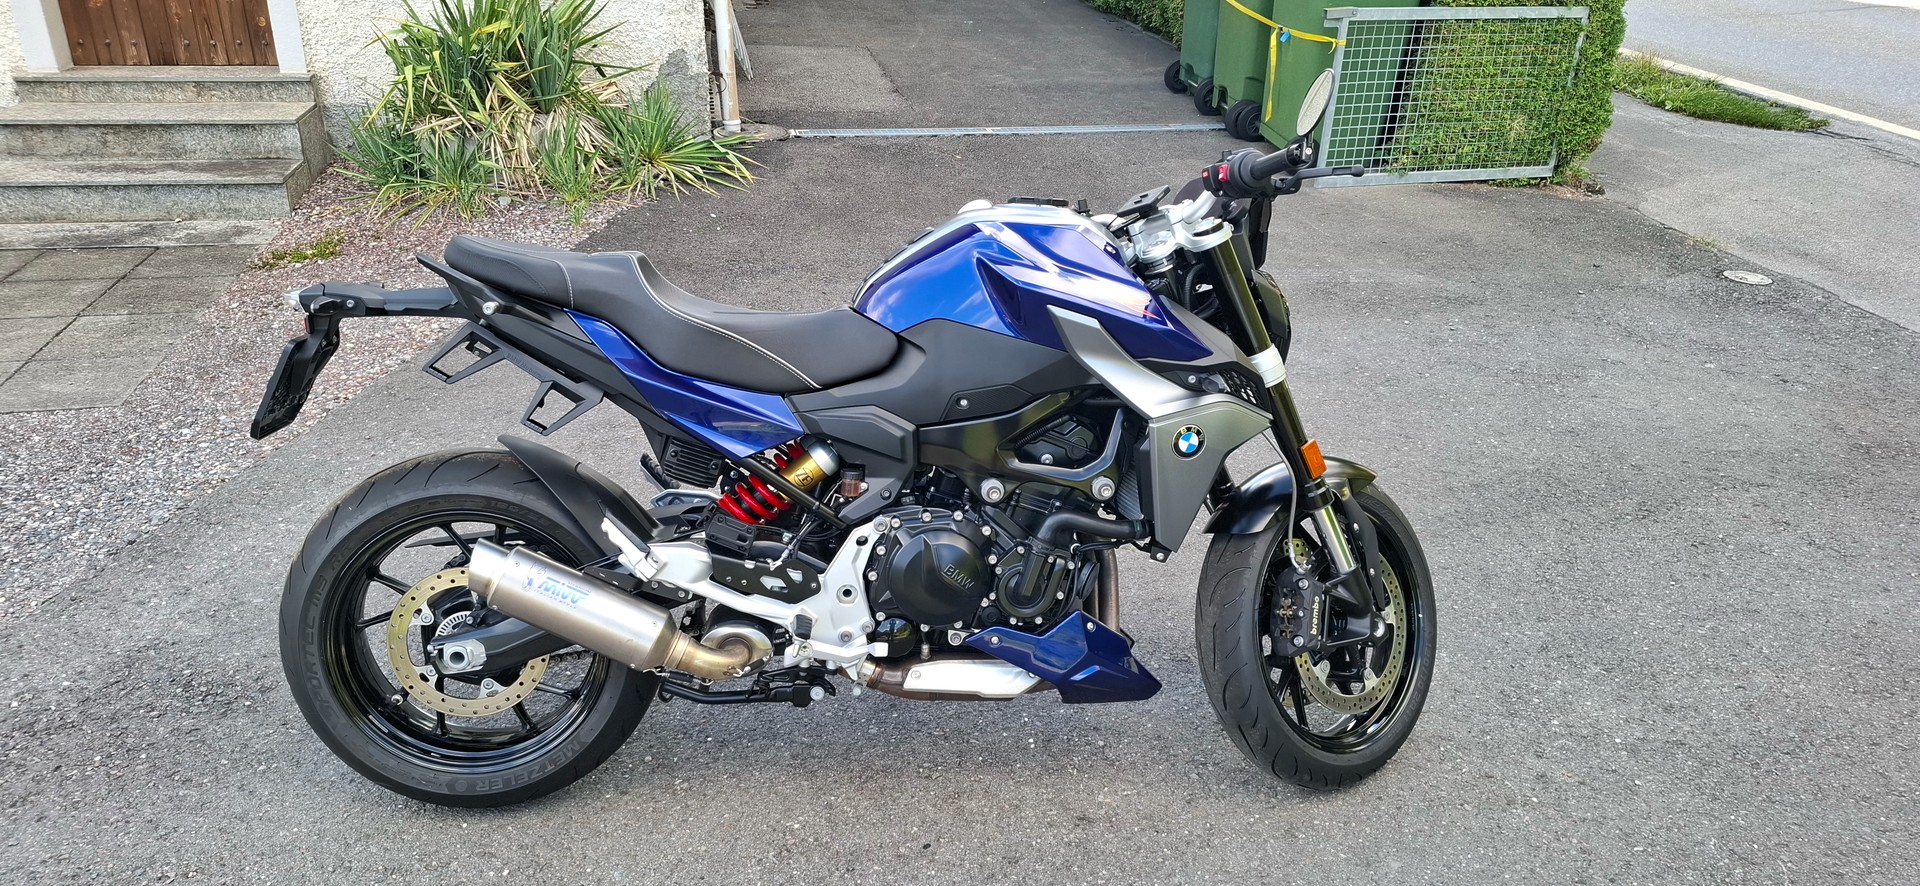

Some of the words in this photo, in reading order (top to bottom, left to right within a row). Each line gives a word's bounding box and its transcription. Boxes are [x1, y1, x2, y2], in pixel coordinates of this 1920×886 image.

[943, 564, 975, 589] BMW
[1310, 596, 1320, 635] brembo
[476, 741, 581, 791] METZELER
